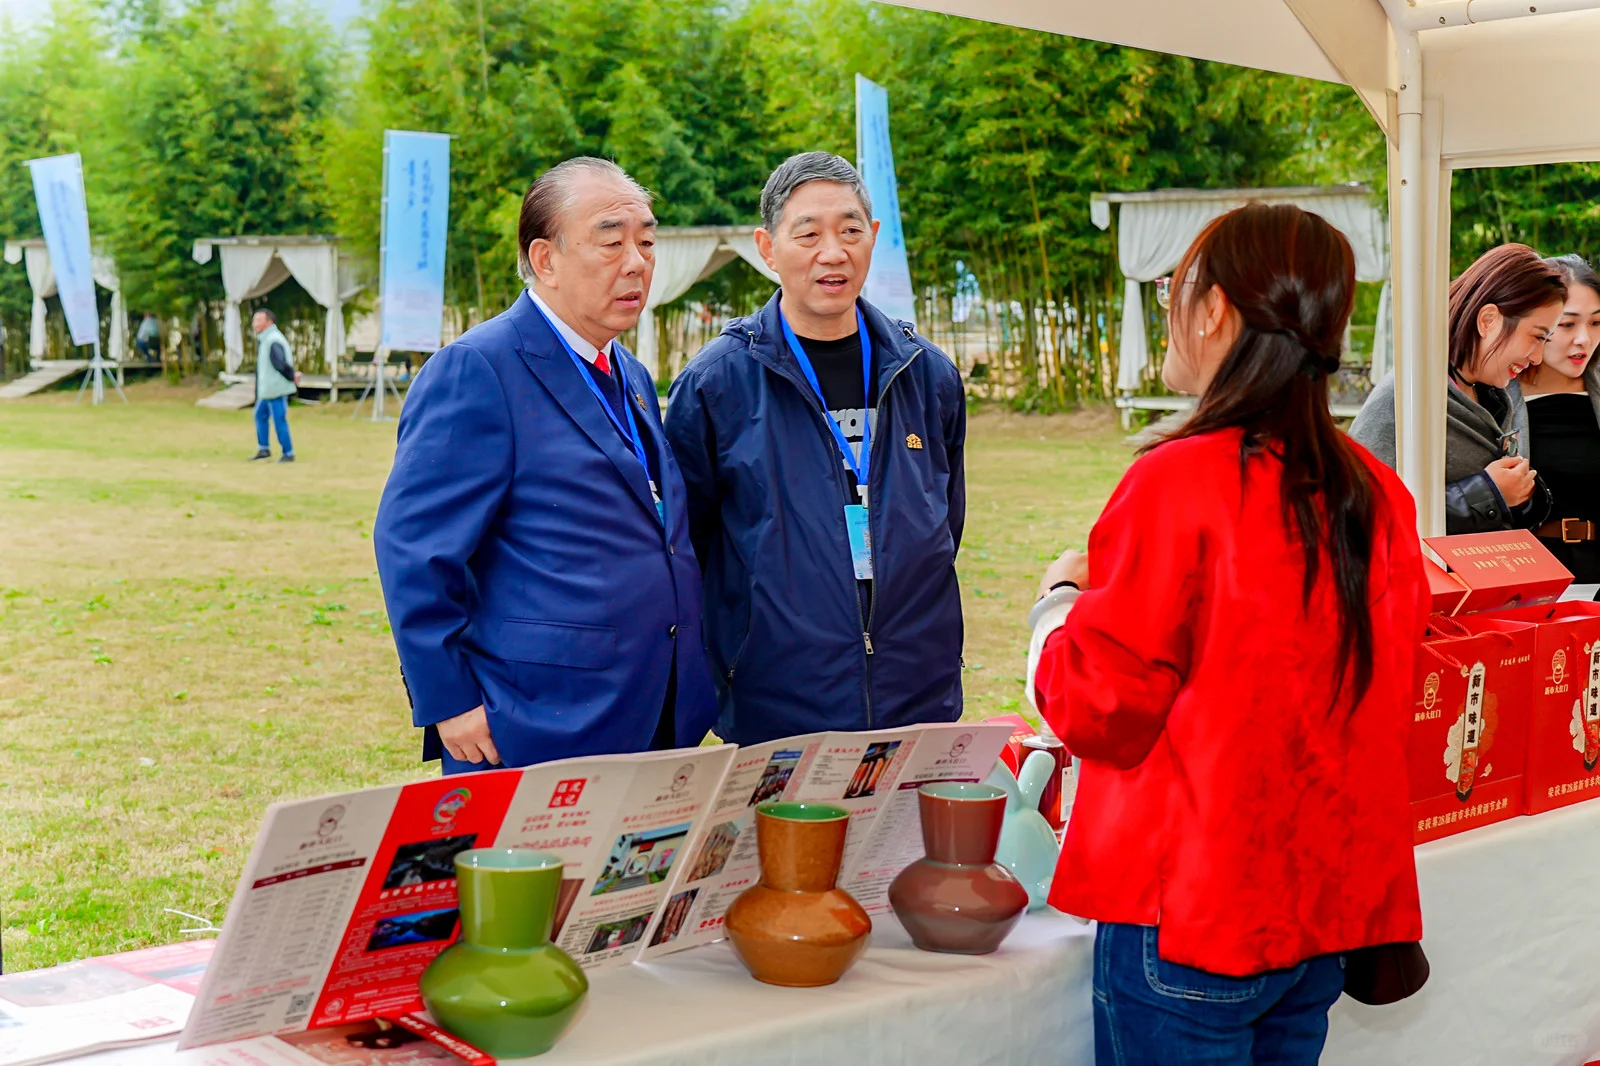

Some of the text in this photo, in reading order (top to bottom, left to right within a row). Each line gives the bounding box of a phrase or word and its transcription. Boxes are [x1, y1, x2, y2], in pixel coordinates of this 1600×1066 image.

[1544, 684, 1568, 696] 新市大红门
[1590, 651, 1600, 716] 新市味道
[1414, 709, 1441, 722] 新市大红门
[1465, 673, 1482, 745] 新市味道
